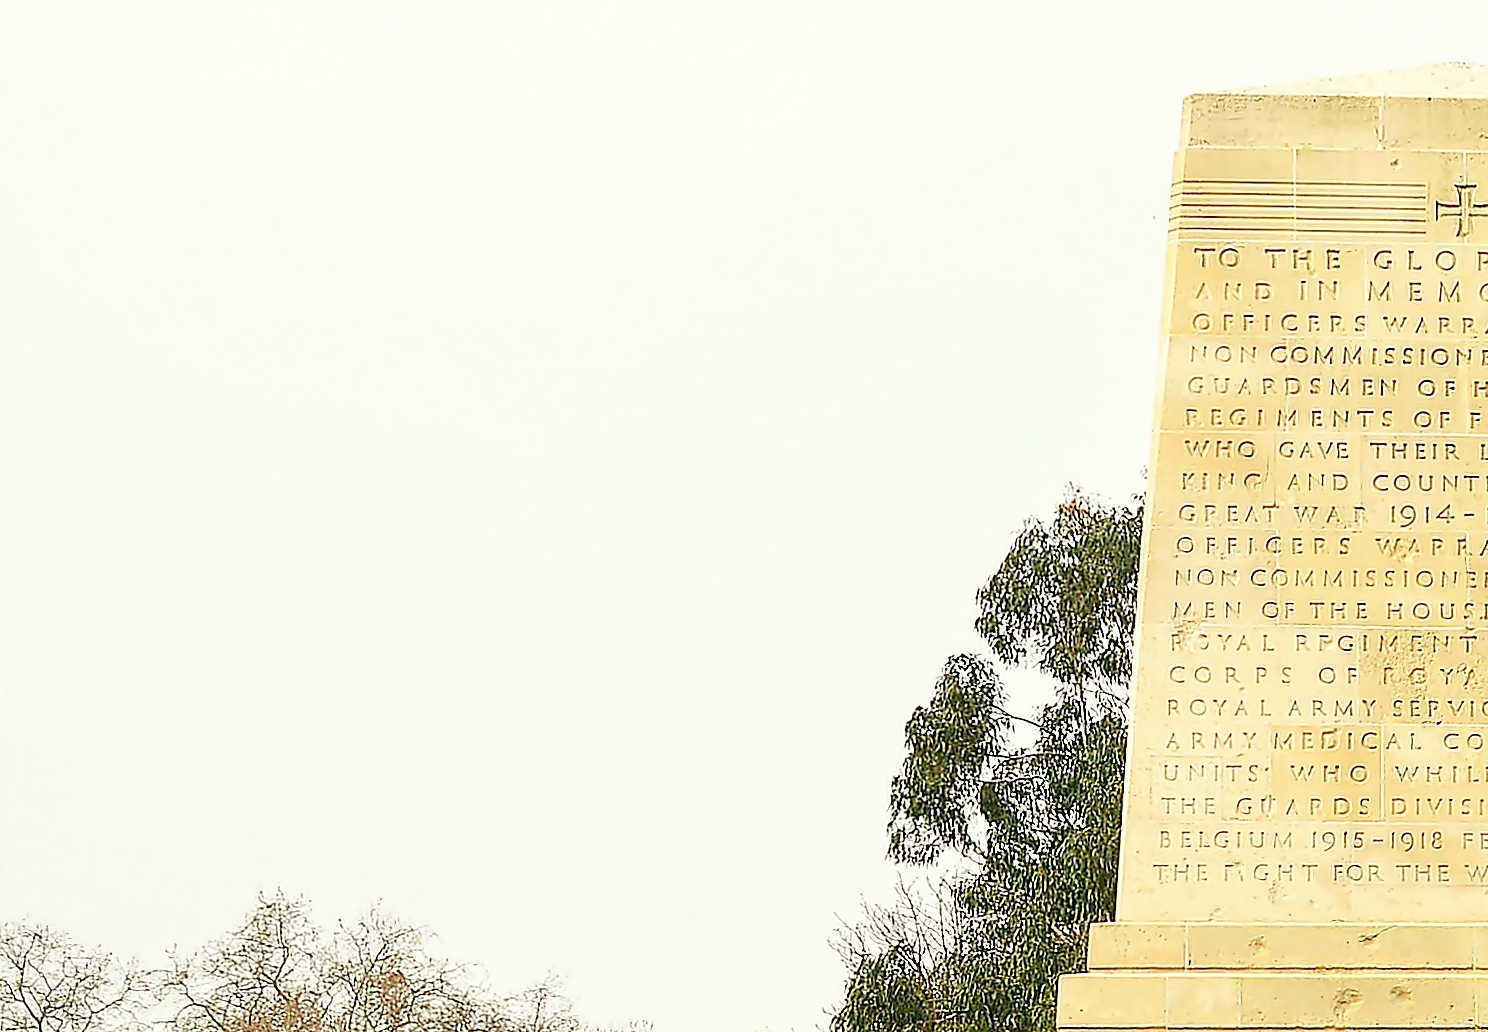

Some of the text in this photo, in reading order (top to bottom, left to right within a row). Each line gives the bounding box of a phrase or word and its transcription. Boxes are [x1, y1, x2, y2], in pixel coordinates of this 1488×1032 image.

[1194, 248, 1239, 269] TO
[1265, 249, 1341, 270] THE
[1195, 282, 1271, 301] AND
[1300, 281, 1338, 301] IN
[1192, 314, 1366, 332] OFFICERS
[1191, 345, 1256, 364] NON
[1188, 376, 1397, 397] GUARDSMEN
[1417, 379, 1456, 397] OF
[1185, 409, 1393, 428] REGIMENTS
[1413, 411, 1451, 429] OF
[1184, 440, 1255, 458] WHO
[1279, 441, 1349, 459] GAVE
[1369, 442, 1461, 460] THEIR
[1182, 473, 1262, 491] KING
[1287, 473, 1349, 491] AND
[1178, 504, 1280, 523] GREAT
[1294, 505, 1368, 524] WAR
[1176, 536, 1351, 555] OFFICERS
[1175, 569, 1238, 587] NON
[1173, 601, 1241, 619] MEN
[1262, 601, 1296, 619] OF
[1309, 601, 1368, 620] THE
[1171, 633, 1276, 652] ROYAL
[1296, 634, 1477, 653] REGIMENT
[1169, 666, 1293, 685] CORPS
[1318, 667, 1358, 685] OF
[1167, 699, 1272, 717] ROYAL
[1288, 699, 1377, 717] ARMY
[1165, 732, 1258, 750] ARMY
[1273, 731, 1422, 751] MEDICAL
[1290, 765, 1368, 783] WHO
[1160, 797, 1216, 815] THE
[1235, 795, 1371, 816] GUARDS
[1159, 830, 1293, 849] BELGIUM
[1153, 864, 1208, 882] THE
[1224, 864, 1318, 882] FIGHT
[1333, 864, 1384, 882] FOR
[1395, 864, 1450, 882] THE
